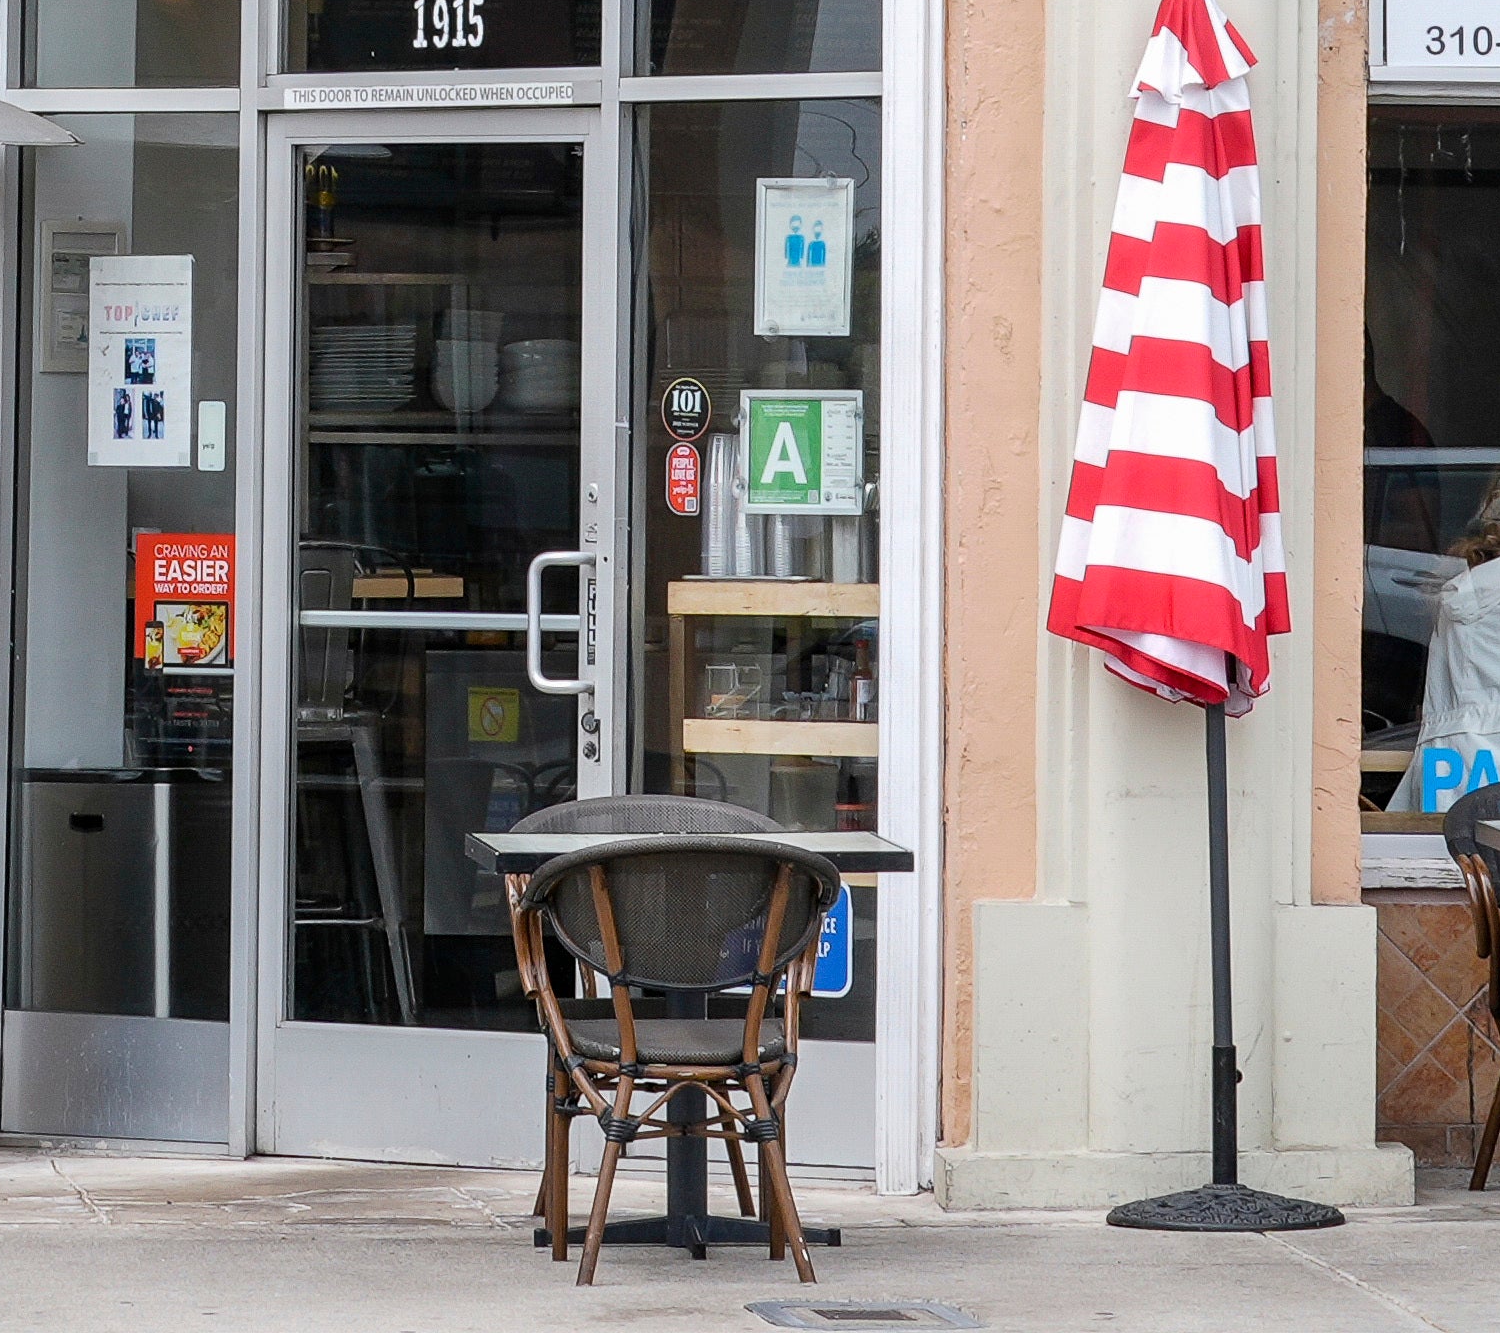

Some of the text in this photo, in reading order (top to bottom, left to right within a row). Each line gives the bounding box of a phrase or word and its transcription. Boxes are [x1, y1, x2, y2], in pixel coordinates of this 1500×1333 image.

[293, 85, 573, 103] THIS DOOR TO REMAIN UNLOCKED WHEN OCCUPIED
[104, 304, 180, 321] TOP CHEF
[671, 390, 702, 413] 101
[760, 421, 808, 484] A
[154, 543, 228, 559] CRAVING AN
[154, 560, 228, 582] EASIER
[154, 583, 228, 594] WAY TO ORDER?
